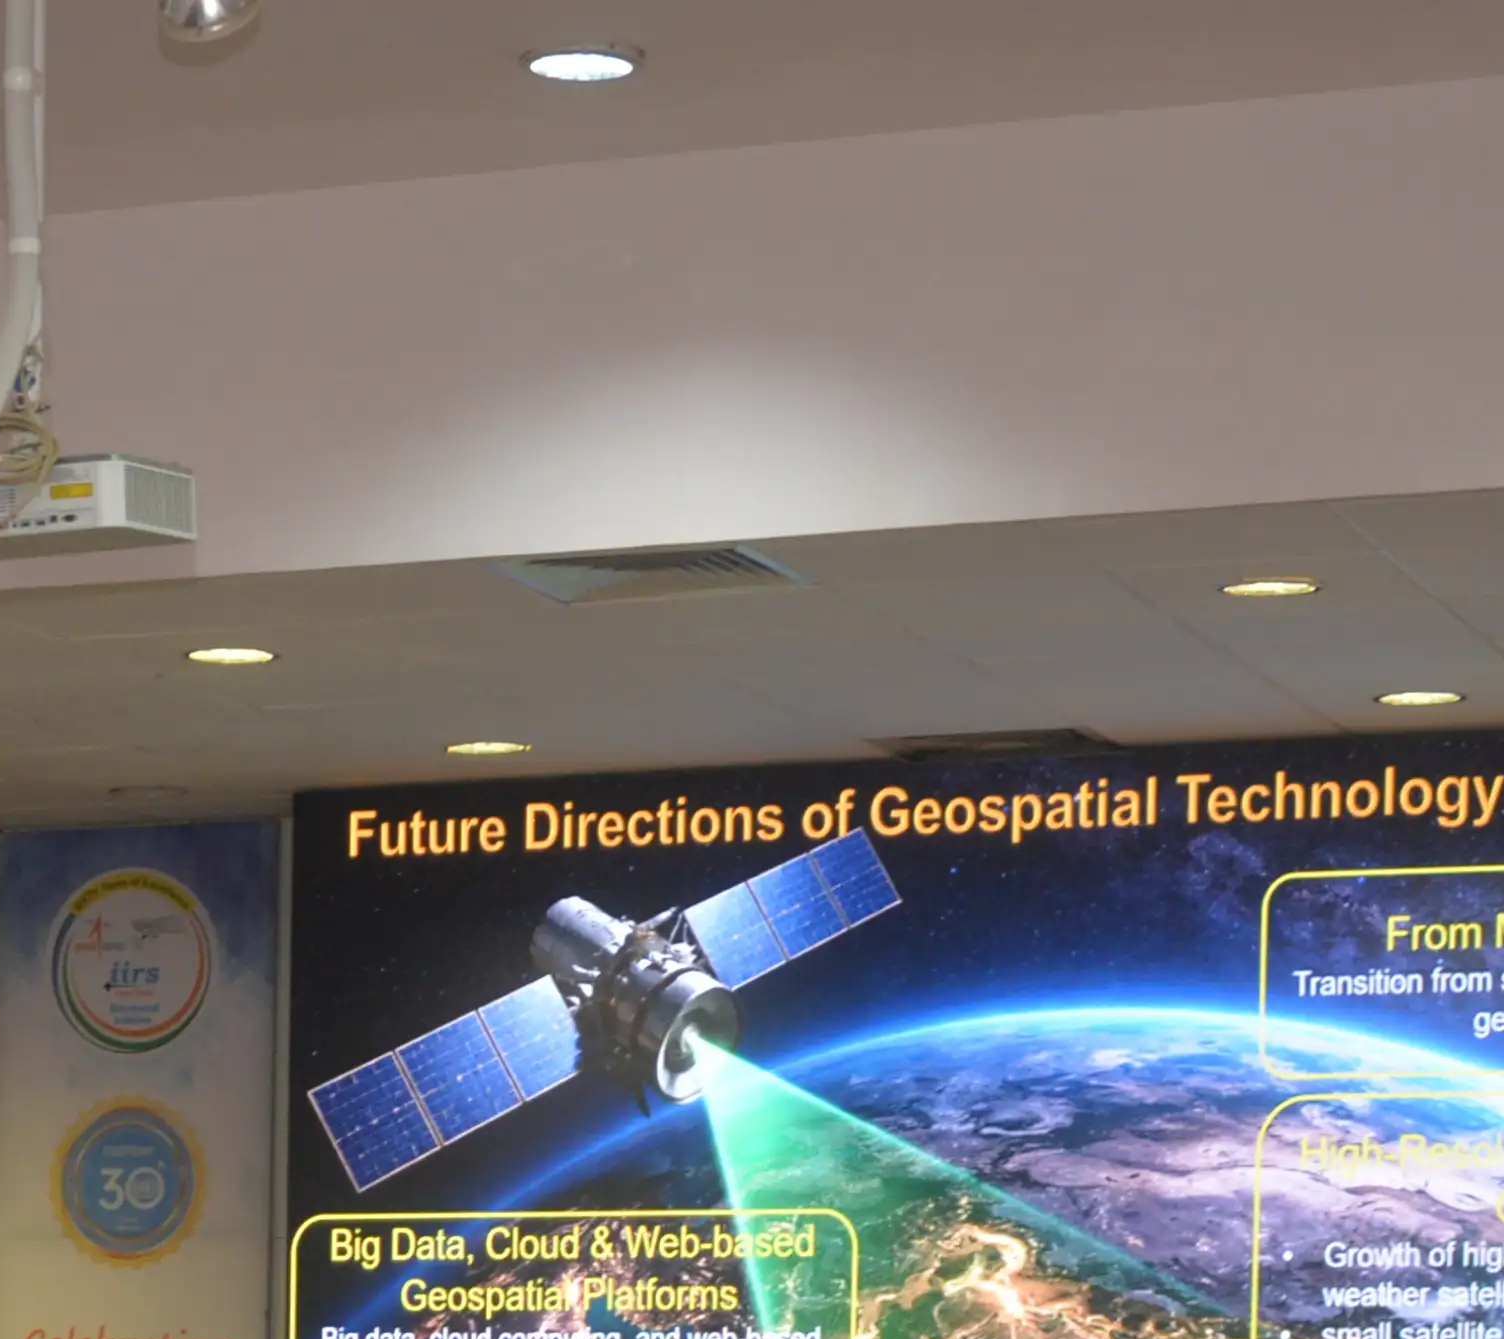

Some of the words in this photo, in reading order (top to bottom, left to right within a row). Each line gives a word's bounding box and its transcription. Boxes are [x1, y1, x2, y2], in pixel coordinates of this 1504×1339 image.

[347, 808, 505, 857] Future
[525, 797, 783, 851] Directions
[802, 790, 854, 839] of
[869, 776, 1157, 842] Geospatial
[1178, 762, 1504, 827] Technology
[1386, 916, 1483, 952] From
[110, 962, 160, 985] iirs
[1294, 967, 1422, 998] Transition
[1431, 964, 1493, 994] from
[330, 1228, 381, 1268] Big
[392, 1228, 474, 1265] Data,
[486, 1226, 580, 1261] Cloud
[591, 1227, 614, 1260] &
[624, 1224, 815, 1260] Web-based
[1324, 1241, 1421, 1270] Growth
[1428, 1240, 1456, 1267] of
[401, 1278, 571, 1317] Geospatial
[582, 1278, 738, 1313] Platforms
[1323, 1281, 1428, 1308] weather
